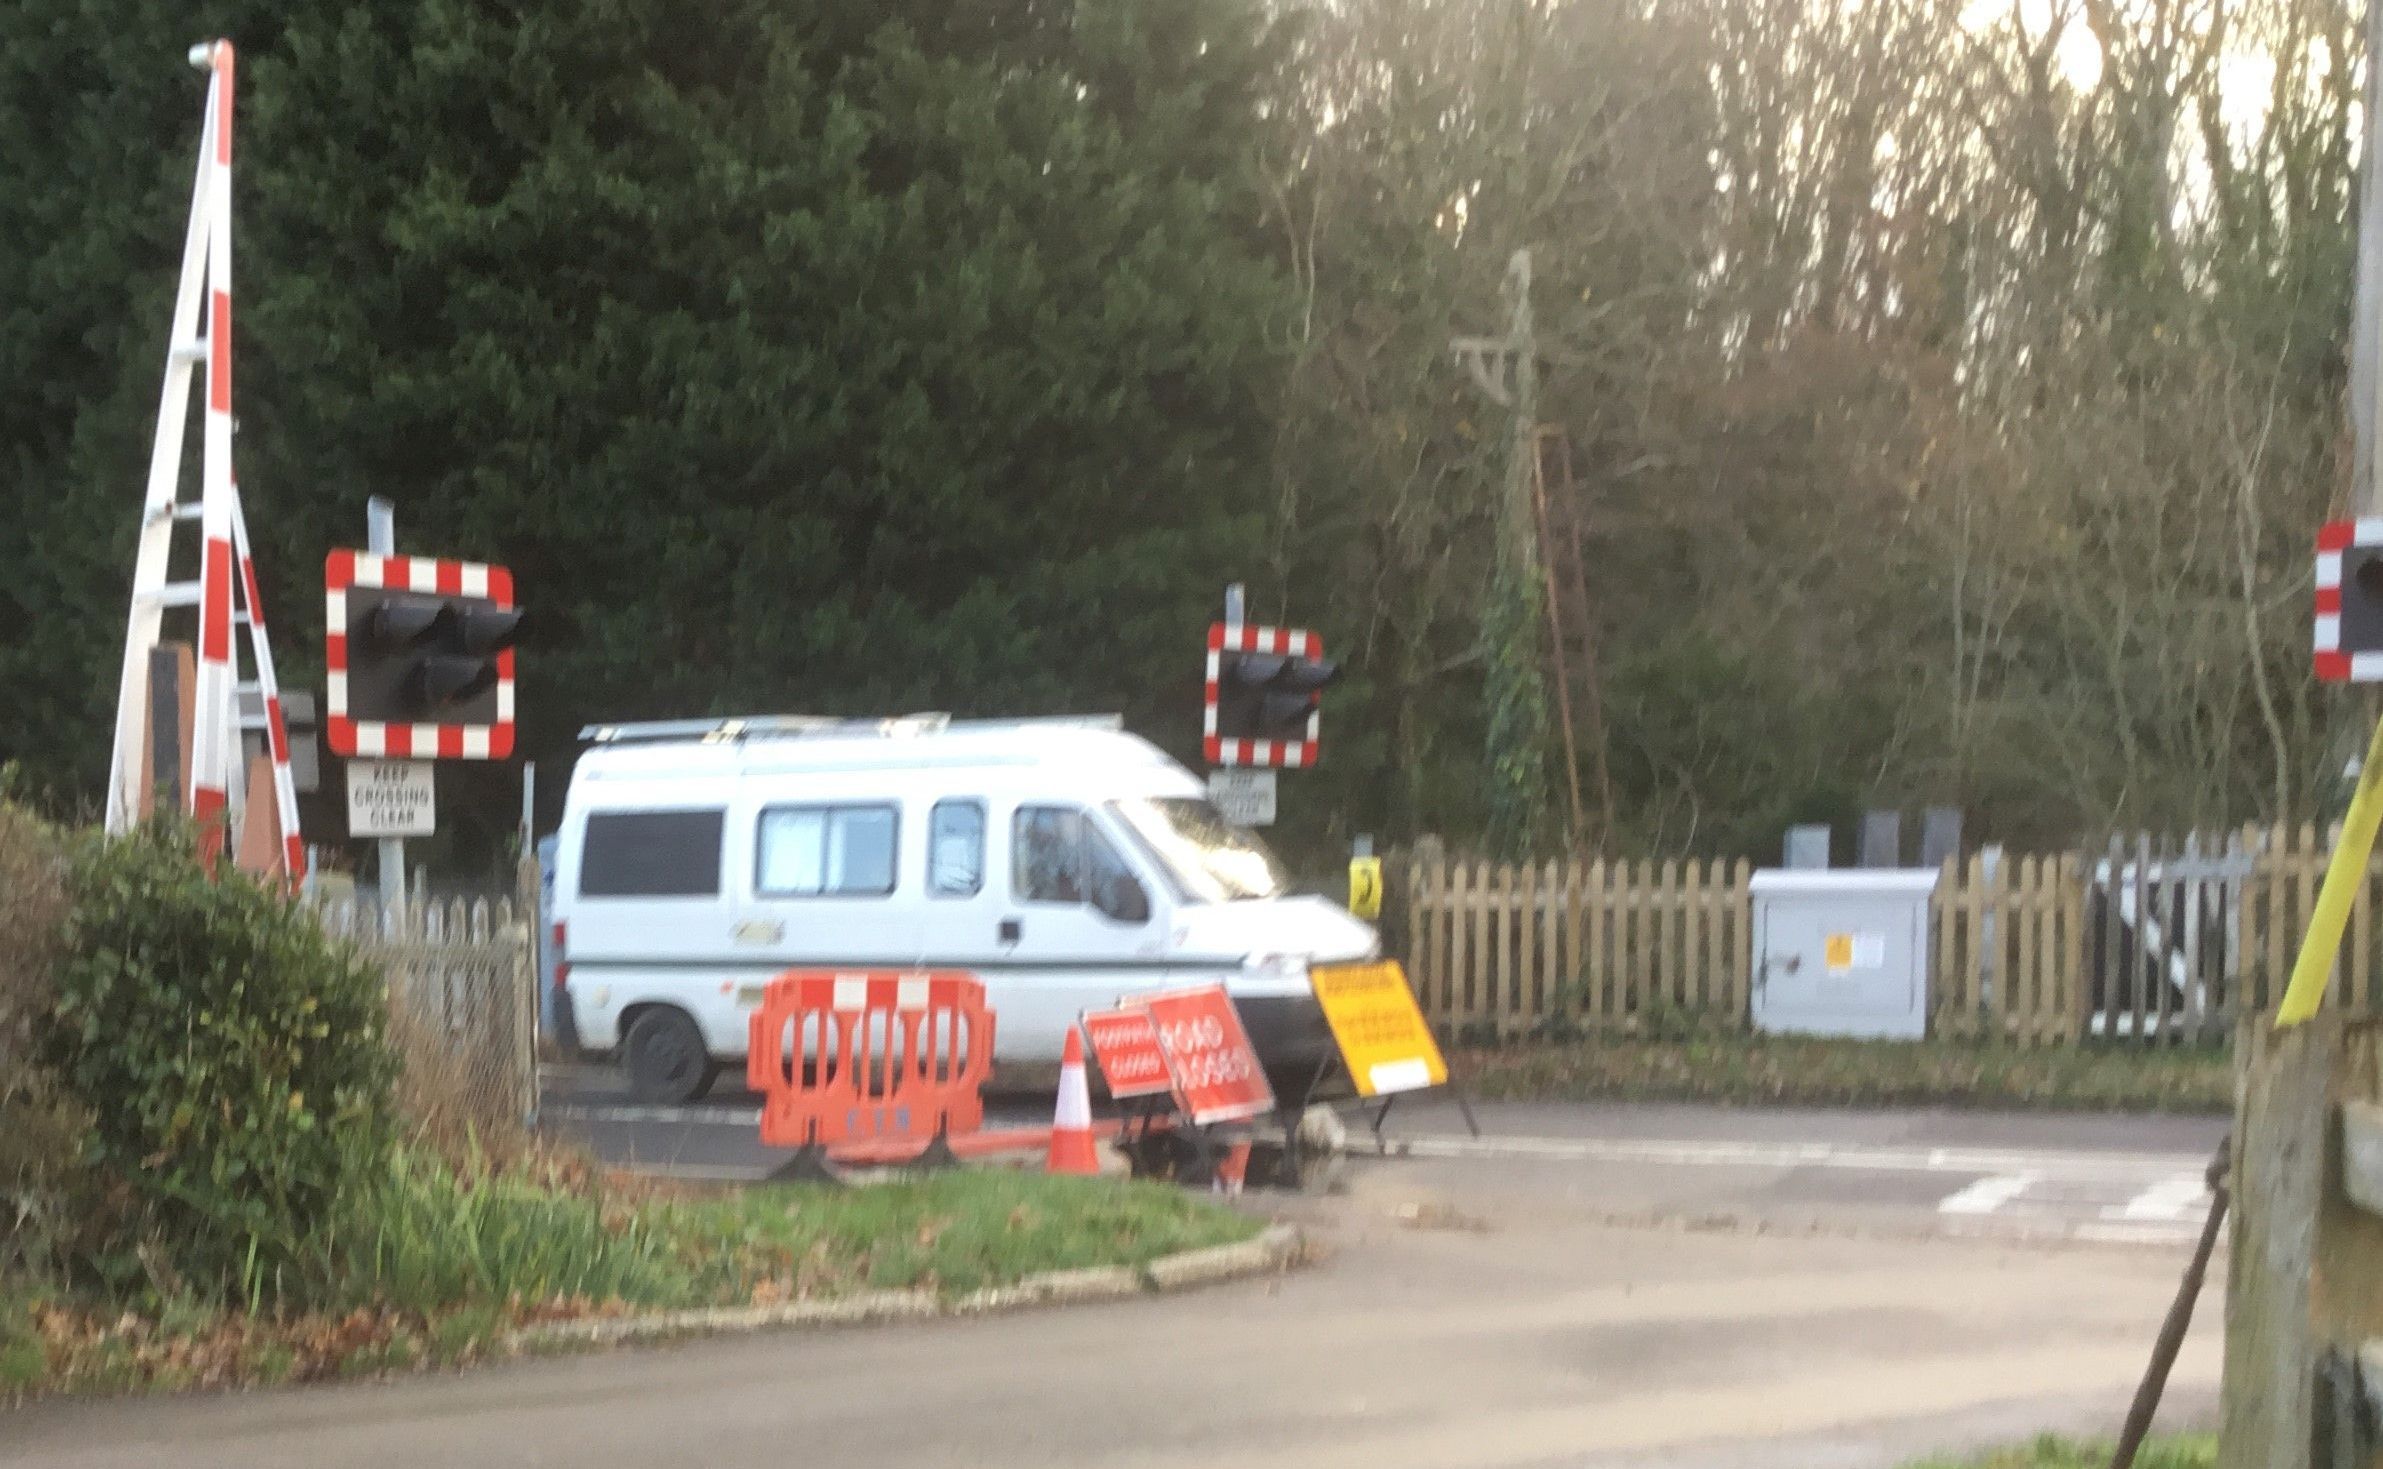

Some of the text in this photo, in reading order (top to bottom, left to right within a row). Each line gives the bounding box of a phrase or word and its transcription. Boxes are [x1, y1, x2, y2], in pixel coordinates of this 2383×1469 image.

[373, 763, 409, 783] KEEP
[354, 785, 429, 807] CROSSING
[370, 807, 415, 828] CLEAR
[1158, 1014, 1224, 1054] ROAD
